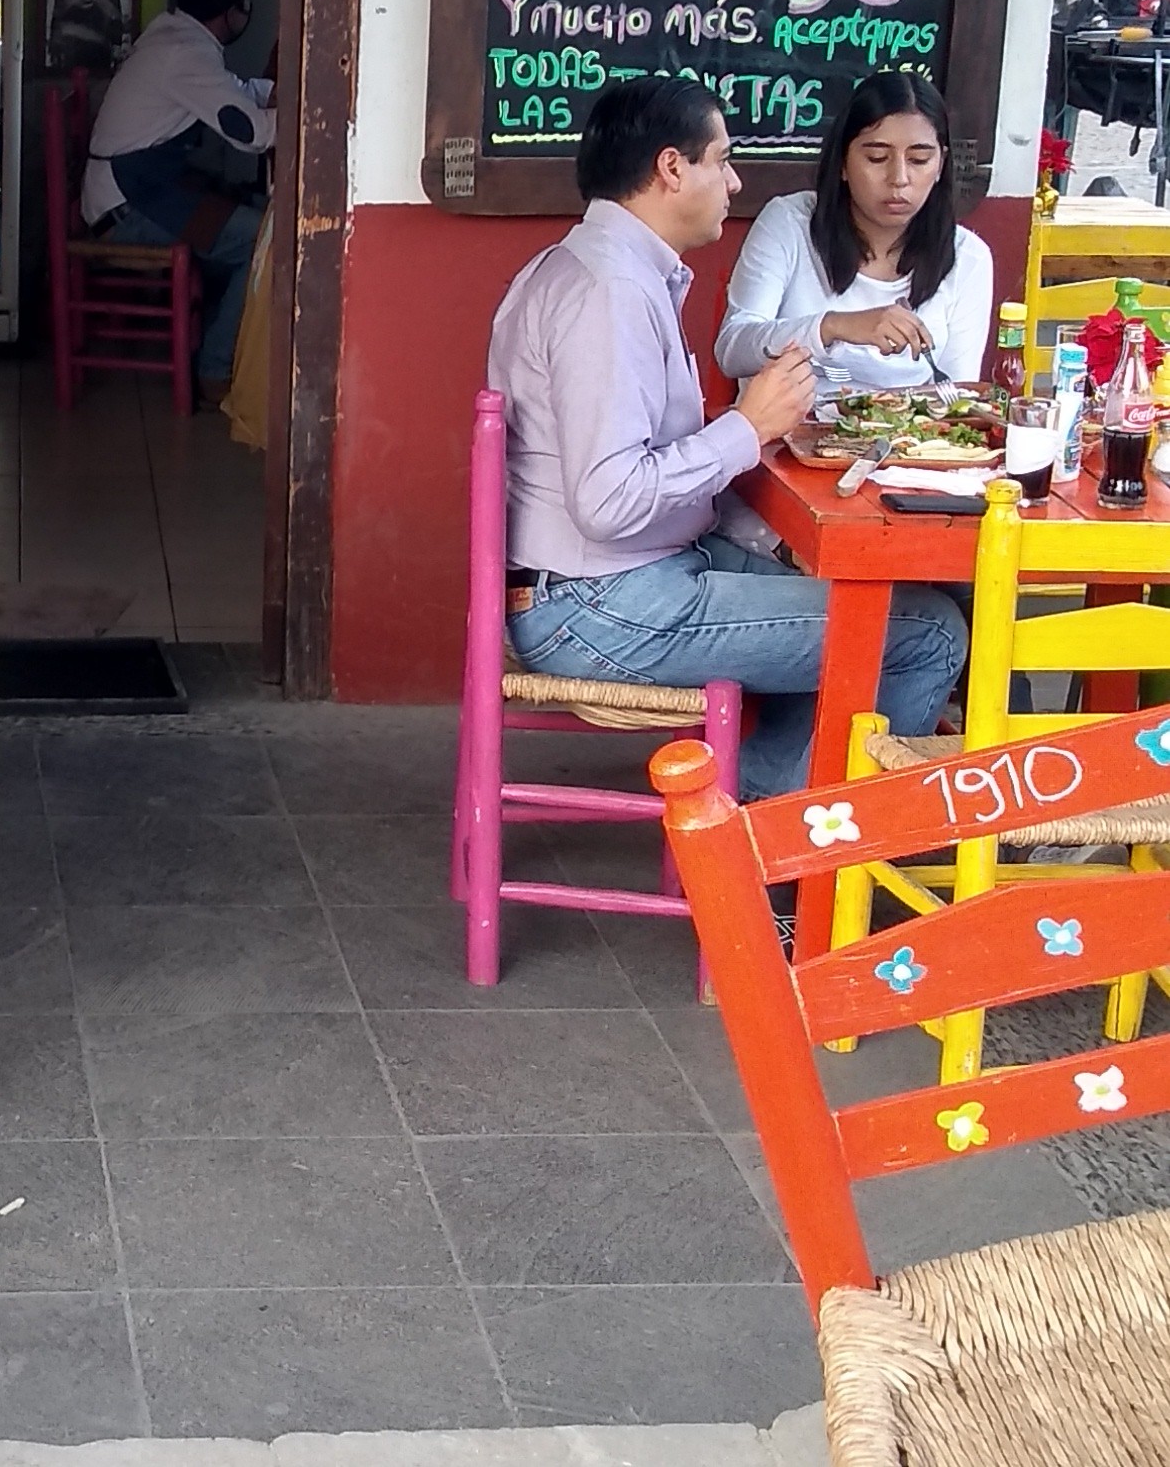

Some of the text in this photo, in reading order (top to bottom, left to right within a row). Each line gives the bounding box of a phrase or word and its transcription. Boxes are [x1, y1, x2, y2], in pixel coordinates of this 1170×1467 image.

[488, 46, 606, 90] TODAS
[498, 94, 573, 130] LAS
[922, 746, 1083, 823] 1910
